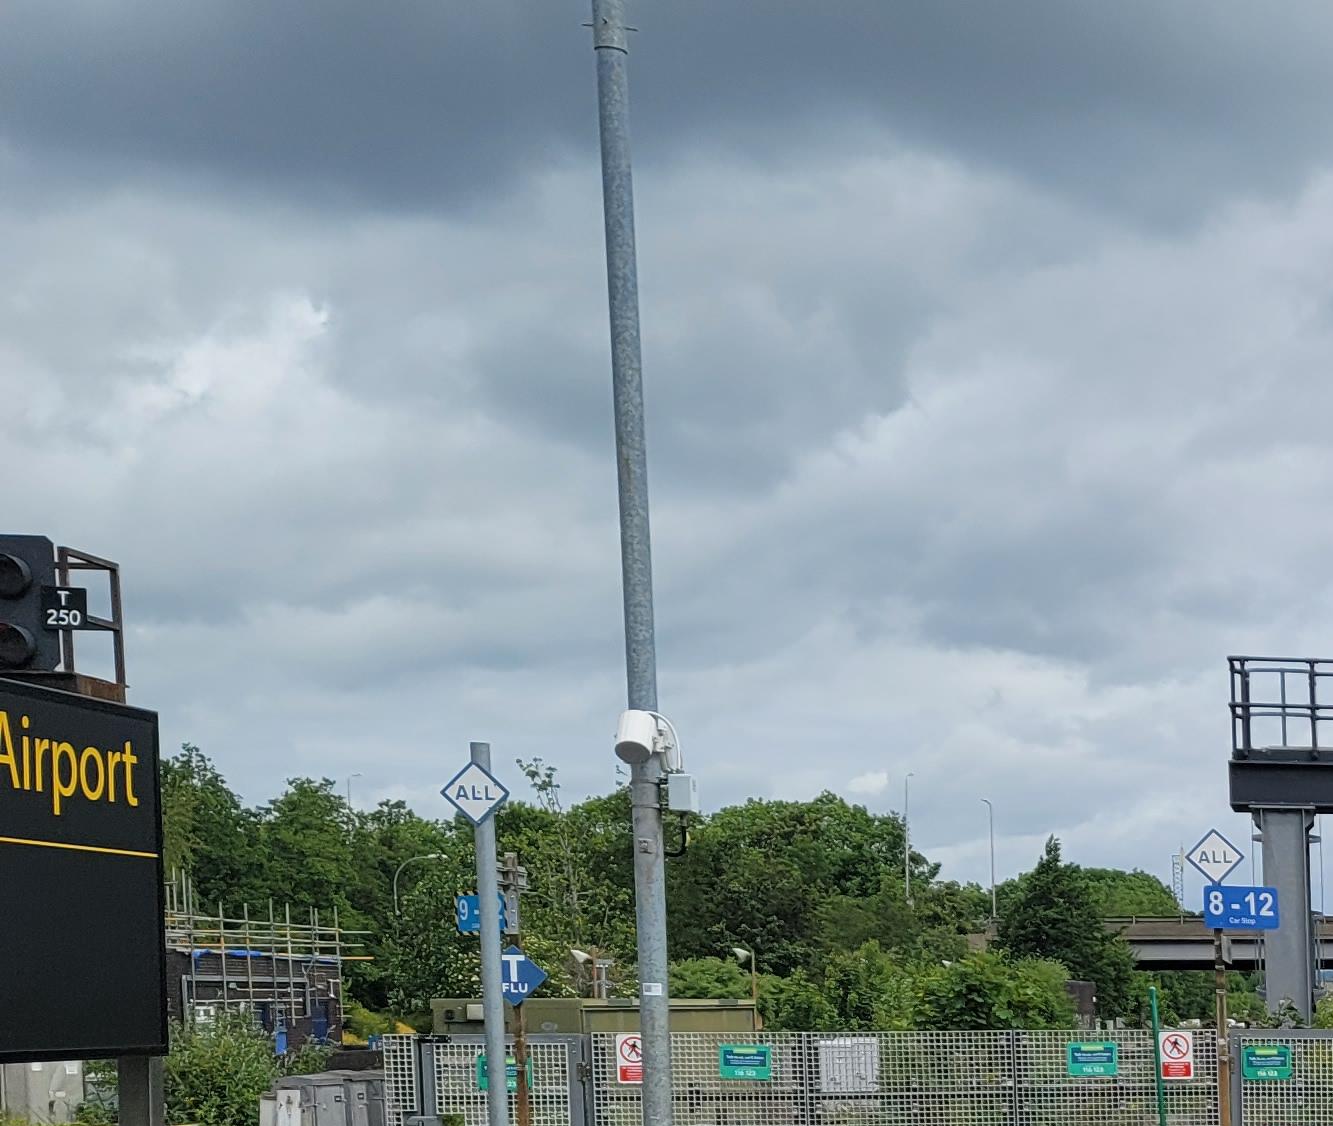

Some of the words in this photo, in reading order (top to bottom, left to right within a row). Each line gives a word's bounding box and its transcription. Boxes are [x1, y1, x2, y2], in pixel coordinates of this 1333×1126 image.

[56, 590, 72, 606] T
[47, 609, 81, 626] 250
[455, 784, 496, 800] ALL
[1198, 850, 1233, 863] ALL
[459, 898, 468, 921] 9
[1244, 891, 1274, 916] 12
[502, 955, 525, 982] T
[502, 983, 528, 993] FLU
